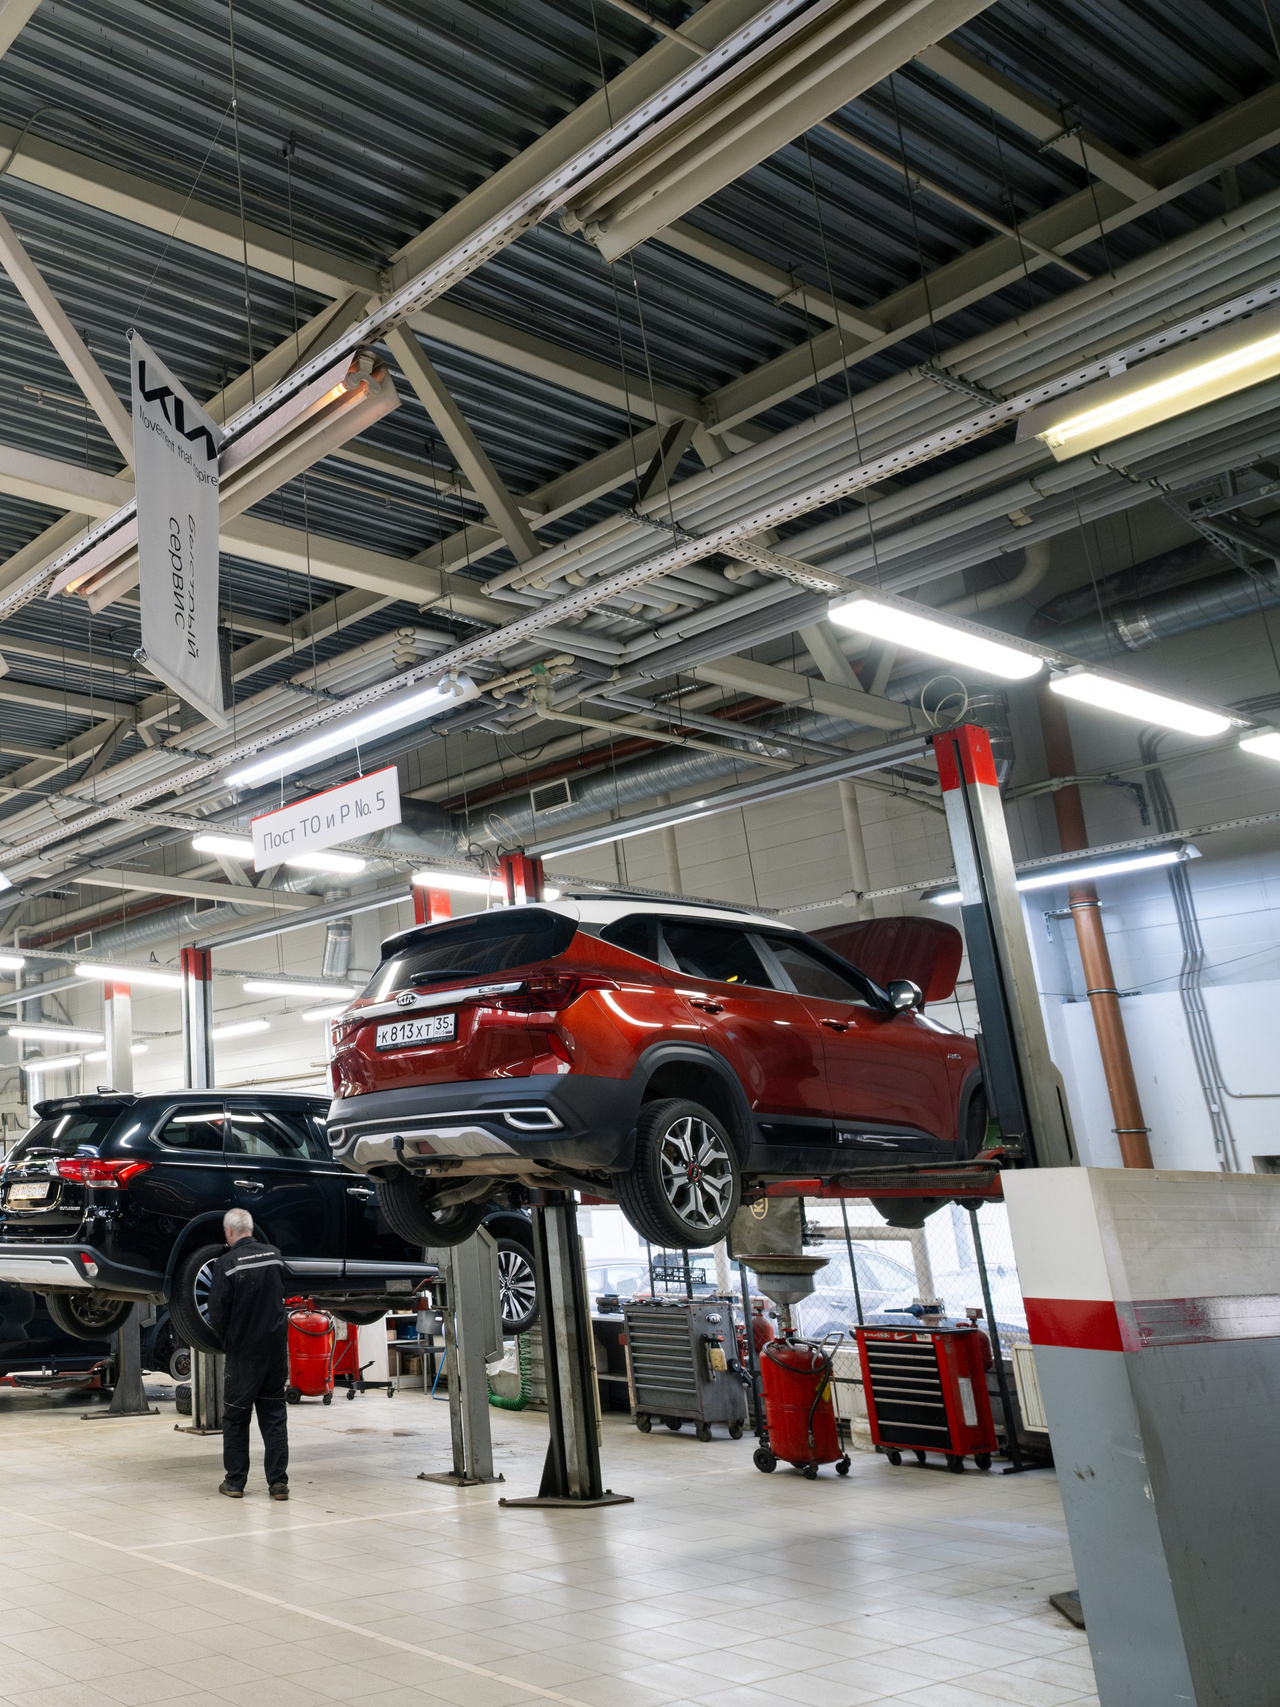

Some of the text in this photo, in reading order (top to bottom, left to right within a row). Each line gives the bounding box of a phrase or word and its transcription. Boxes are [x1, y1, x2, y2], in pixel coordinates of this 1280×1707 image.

[138, 360, 218, 461] KIA
[169, 517, 185, 630] сервис
[187, 514, 200, 659] Быстрый
[263, 828, 296, 851] Пост
[300, 815, 321, 837] ТО
[326, 813, 335, 829] и
[340, 804, 350, 824] Р
[376, 790, 385, 811] 5
[381, 1017, 449, 1043] К813ХТ 35
